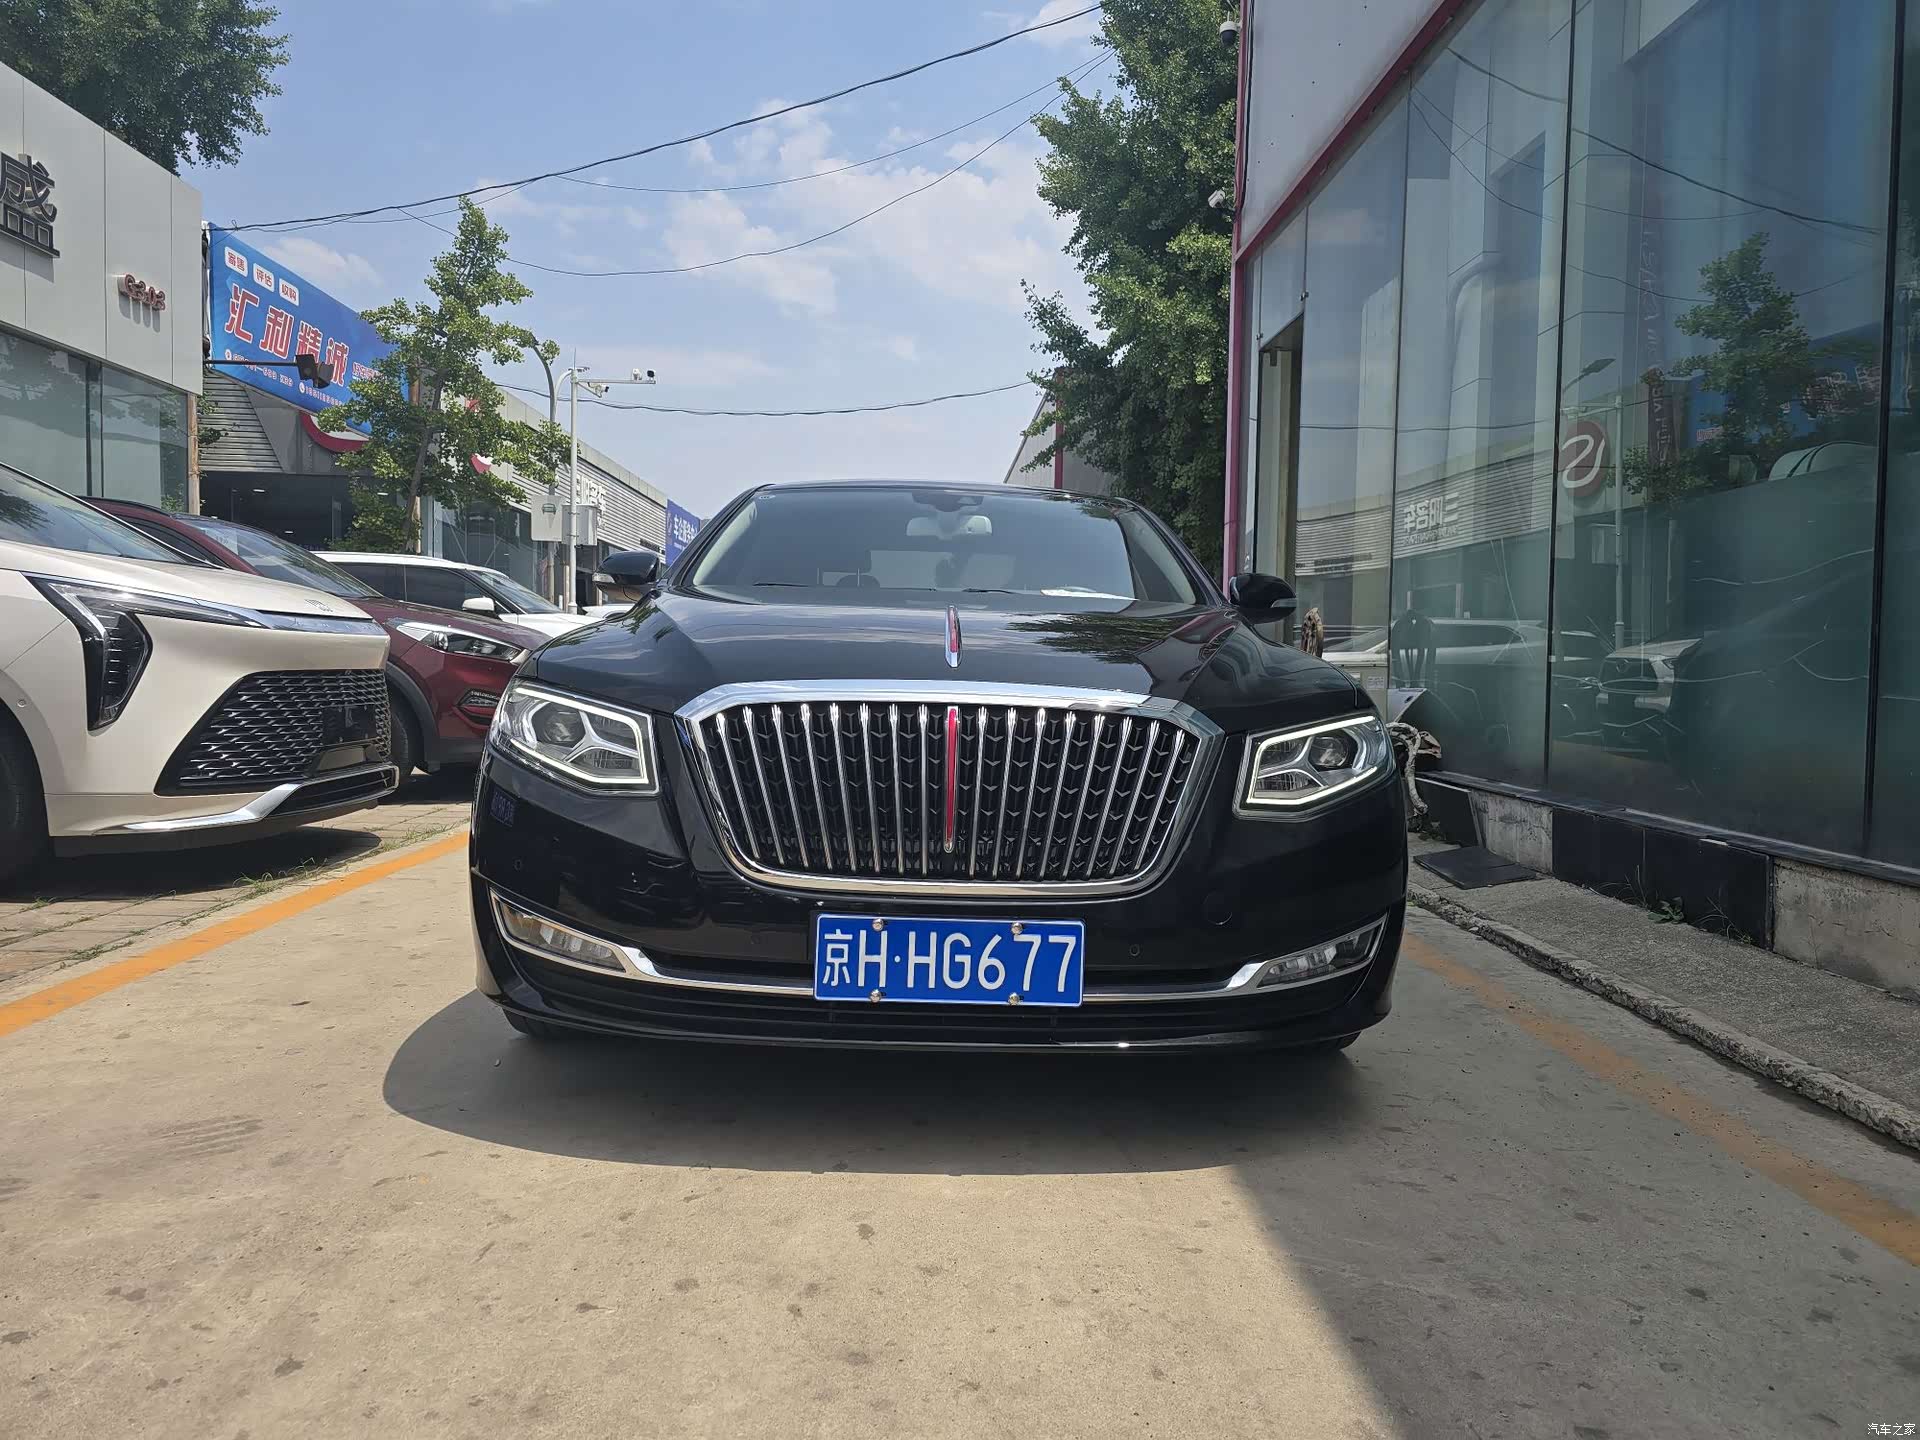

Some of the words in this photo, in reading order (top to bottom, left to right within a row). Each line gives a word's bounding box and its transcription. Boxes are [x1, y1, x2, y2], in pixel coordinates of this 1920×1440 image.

[256, 267, 273, 288] 评估
[281, 283, 297, 301] 收购
[224, 283, 349, 387] 汇利精诚
